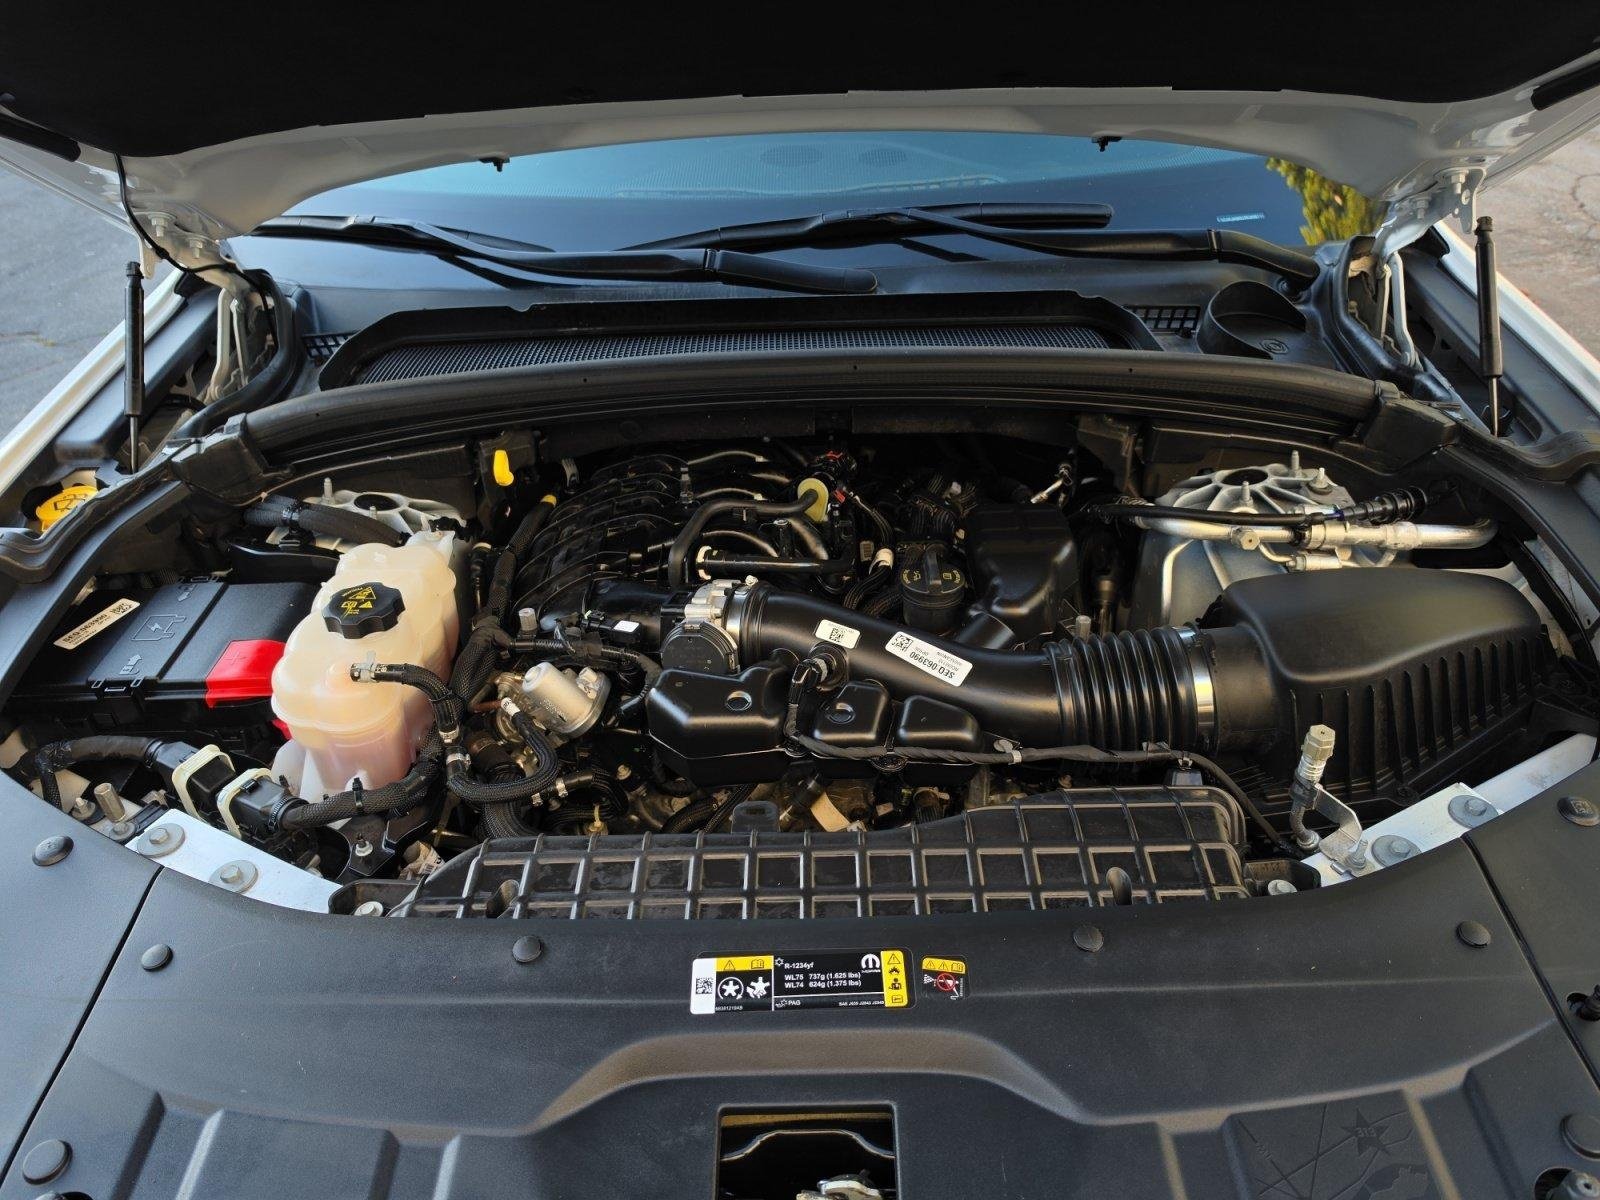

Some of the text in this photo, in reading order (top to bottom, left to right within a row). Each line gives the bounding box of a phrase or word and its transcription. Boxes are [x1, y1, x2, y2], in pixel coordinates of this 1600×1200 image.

[909, 651, 938, 671] 063990
[784, 961, 814, 969] R-1234yf
[808, 973, 826, 981] 737g
[826, 972, 847, 980] (1.625
[847, 971, 861, 979] lbs)
[808, 981, 826, 989] 624g
[826, 980, 848, 988] (1.375
[848, 979, 862, 987] lbs)
